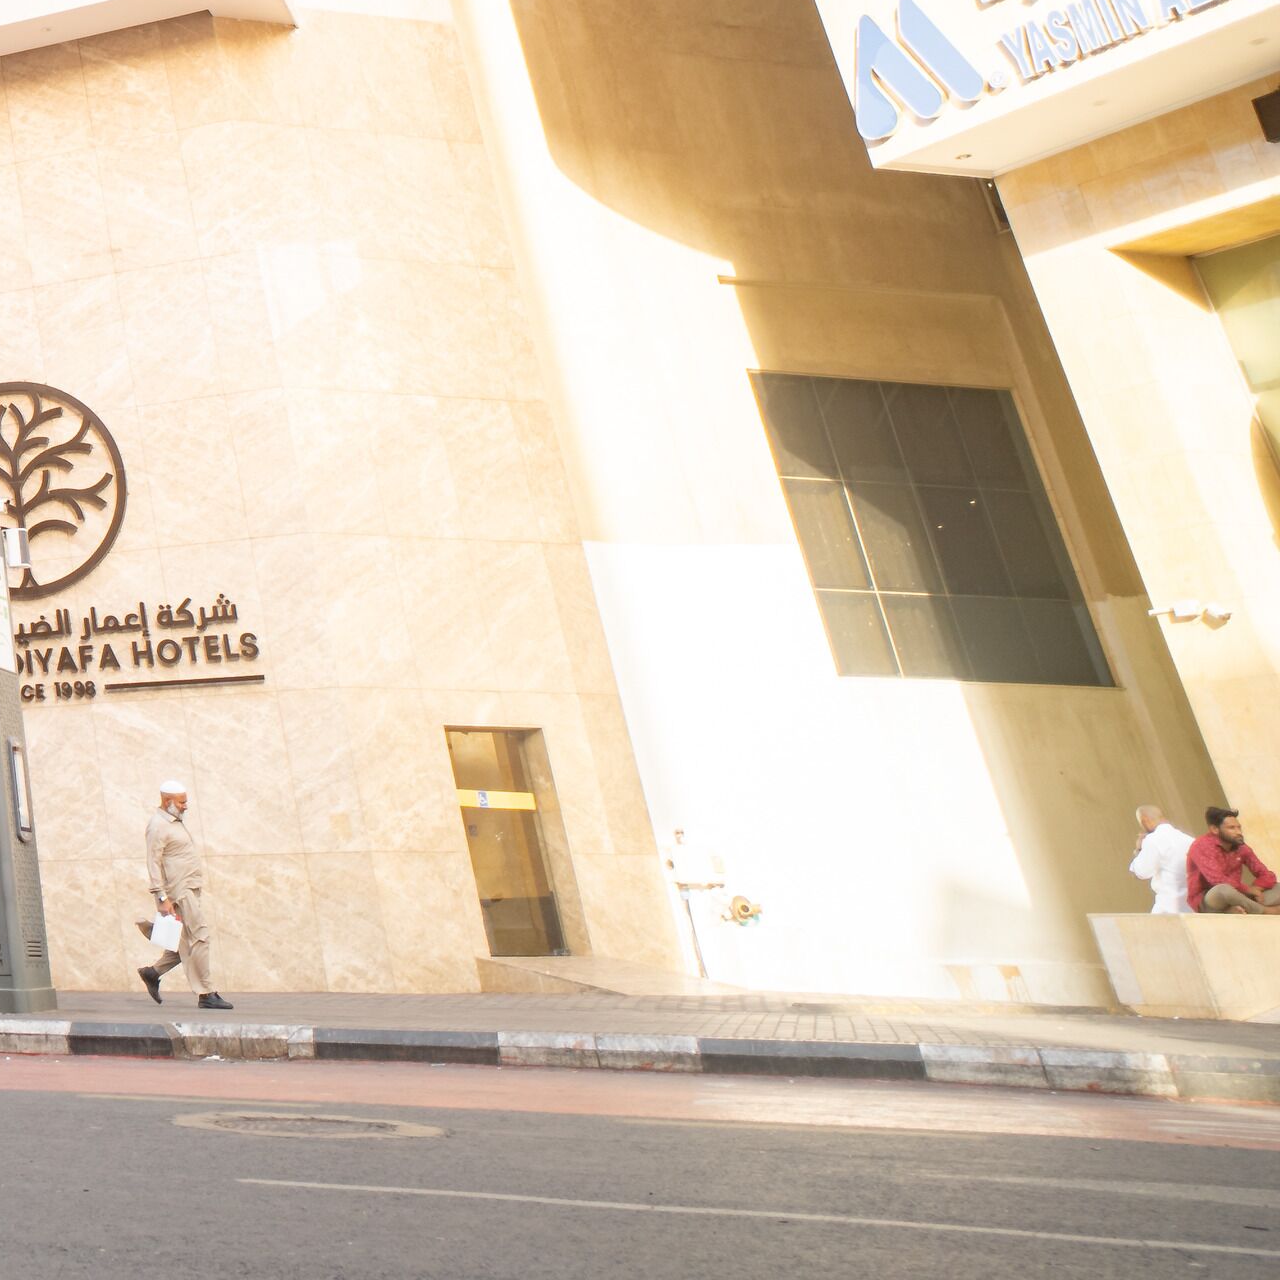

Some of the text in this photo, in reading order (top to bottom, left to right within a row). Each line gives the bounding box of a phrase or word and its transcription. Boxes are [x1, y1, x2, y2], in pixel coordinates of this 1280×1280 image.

[156, 593, 239, 632] شركة
[131, 632, 260, 668] HOTELS
[53, 680, 97, 700] 1998
